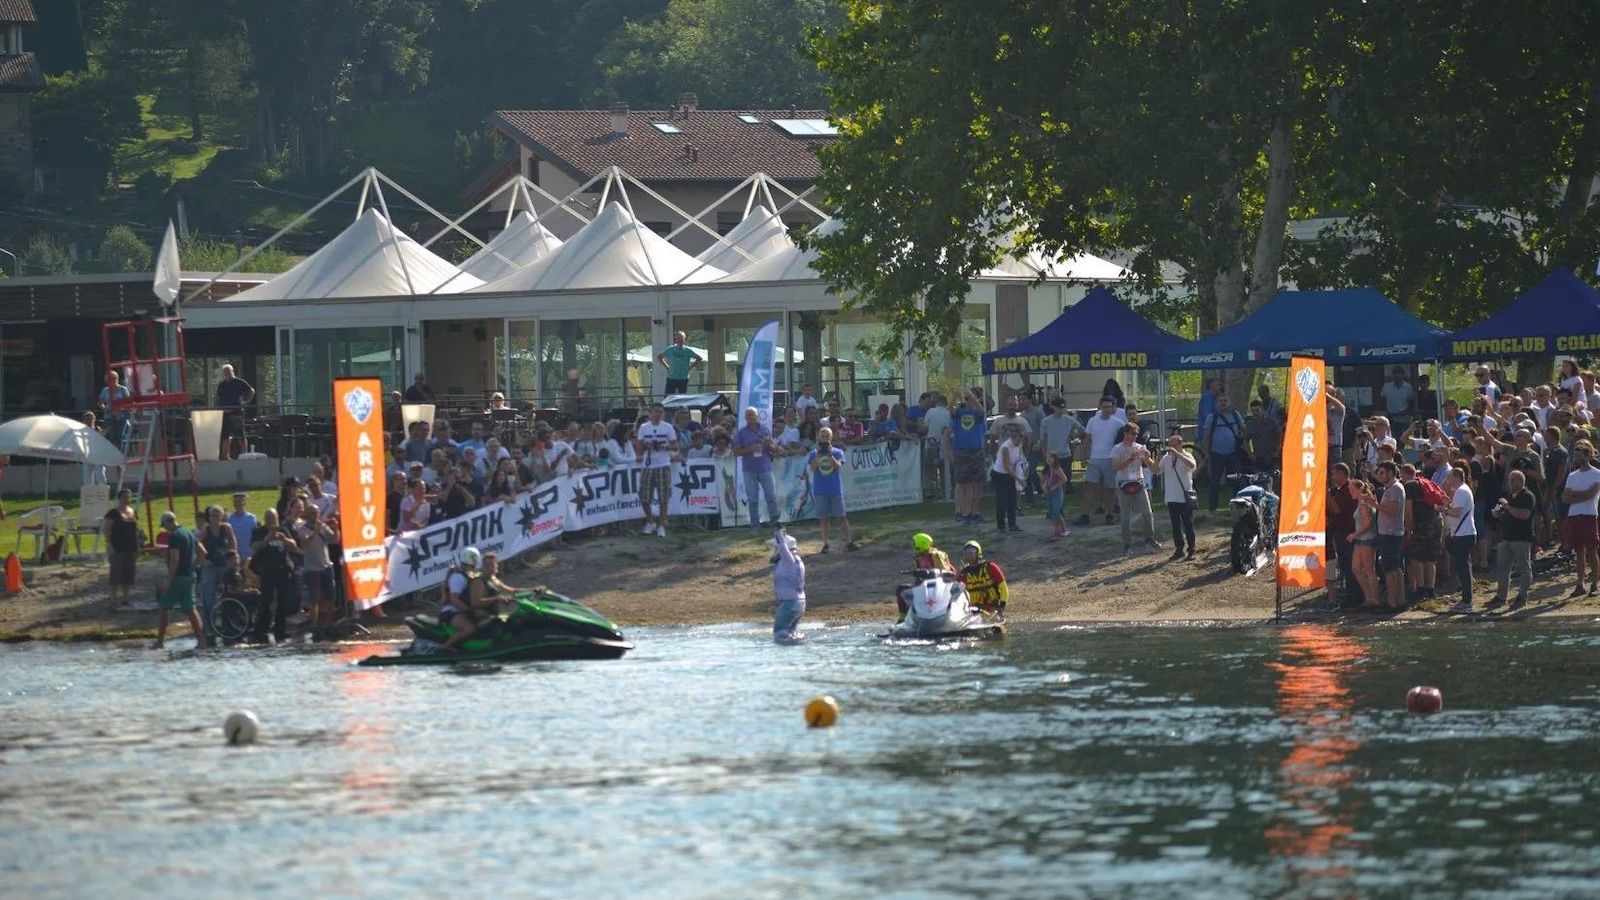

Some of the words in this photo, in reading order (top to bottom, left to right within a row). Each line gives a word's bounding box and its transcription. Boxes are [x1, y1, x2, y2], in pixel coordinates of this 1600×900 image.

[993, 354, 1080, 372] MOTOCLUB
[1090, 352, 1148, 368] COLICO
[1452, 337, 1545, 356] MOTOCLUB
[357, 431, 377, 540] ARRIVO
[1296, 413, 1316, 526] ARRIVO
